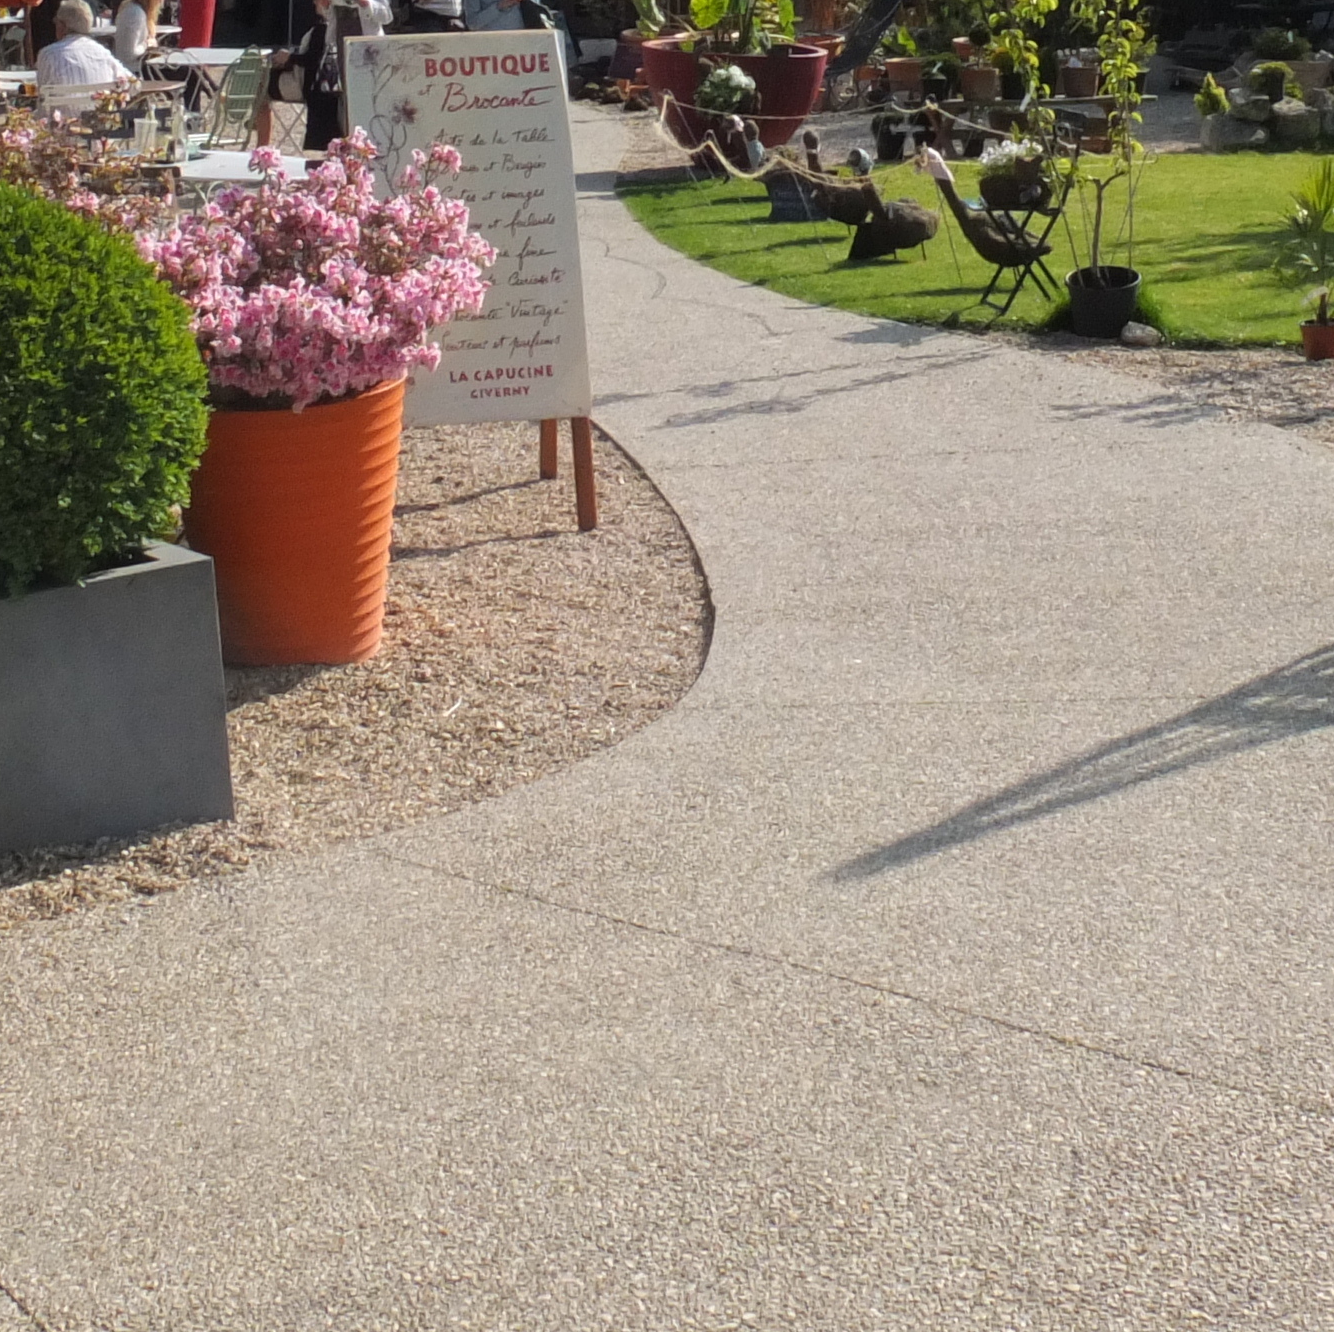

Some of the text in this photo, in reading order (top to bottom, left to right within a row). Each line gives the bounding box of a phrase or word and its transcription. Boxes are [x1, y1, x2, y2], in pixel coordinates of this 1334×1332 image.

[424, 52, 551, 78] BOUTIQUE
[441, 82, 557, 113] Brocante
[469, 133, 488, 146] de
[492, 129, 509, 145] la
[512, 127, 555, 143] Table
[501, 188, 545, 210] images
[449, 365, 554, 383] LA CAPUCINE
